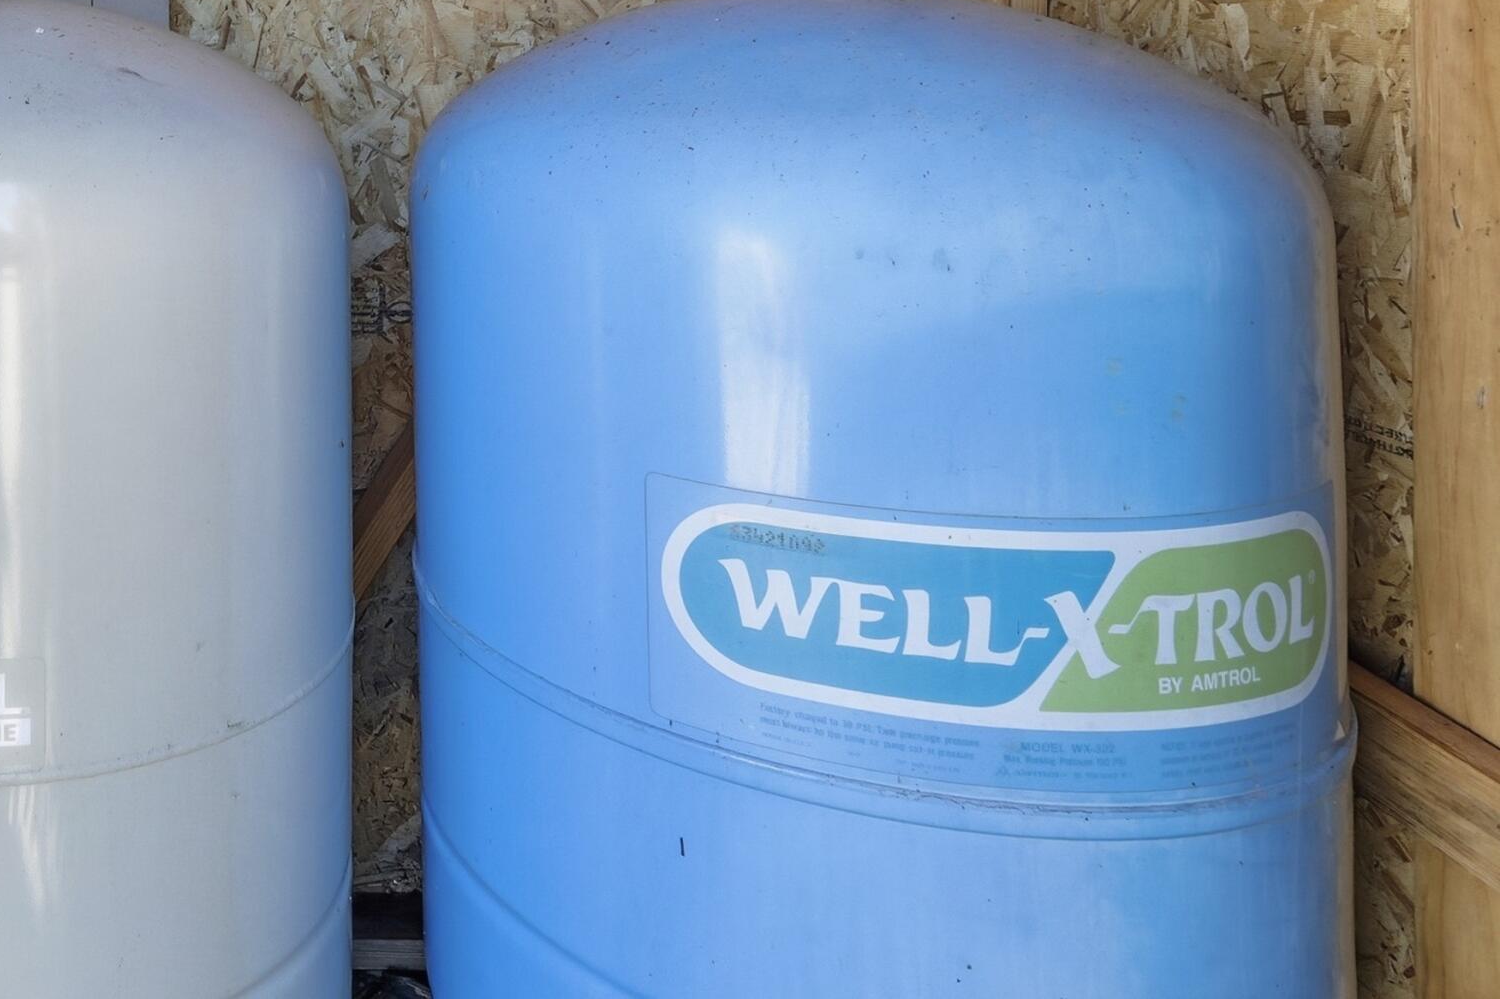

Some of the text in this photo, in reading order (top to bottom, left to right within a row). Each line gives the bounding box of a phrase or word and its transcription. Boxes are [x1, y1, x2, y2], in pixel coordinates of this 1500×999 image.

[718, 556, 1315, 679] WELL-X-TROL
[1158, 666, 1262, 694] BY AMTROL
[1019, 741, 1065, 753] MODEL
